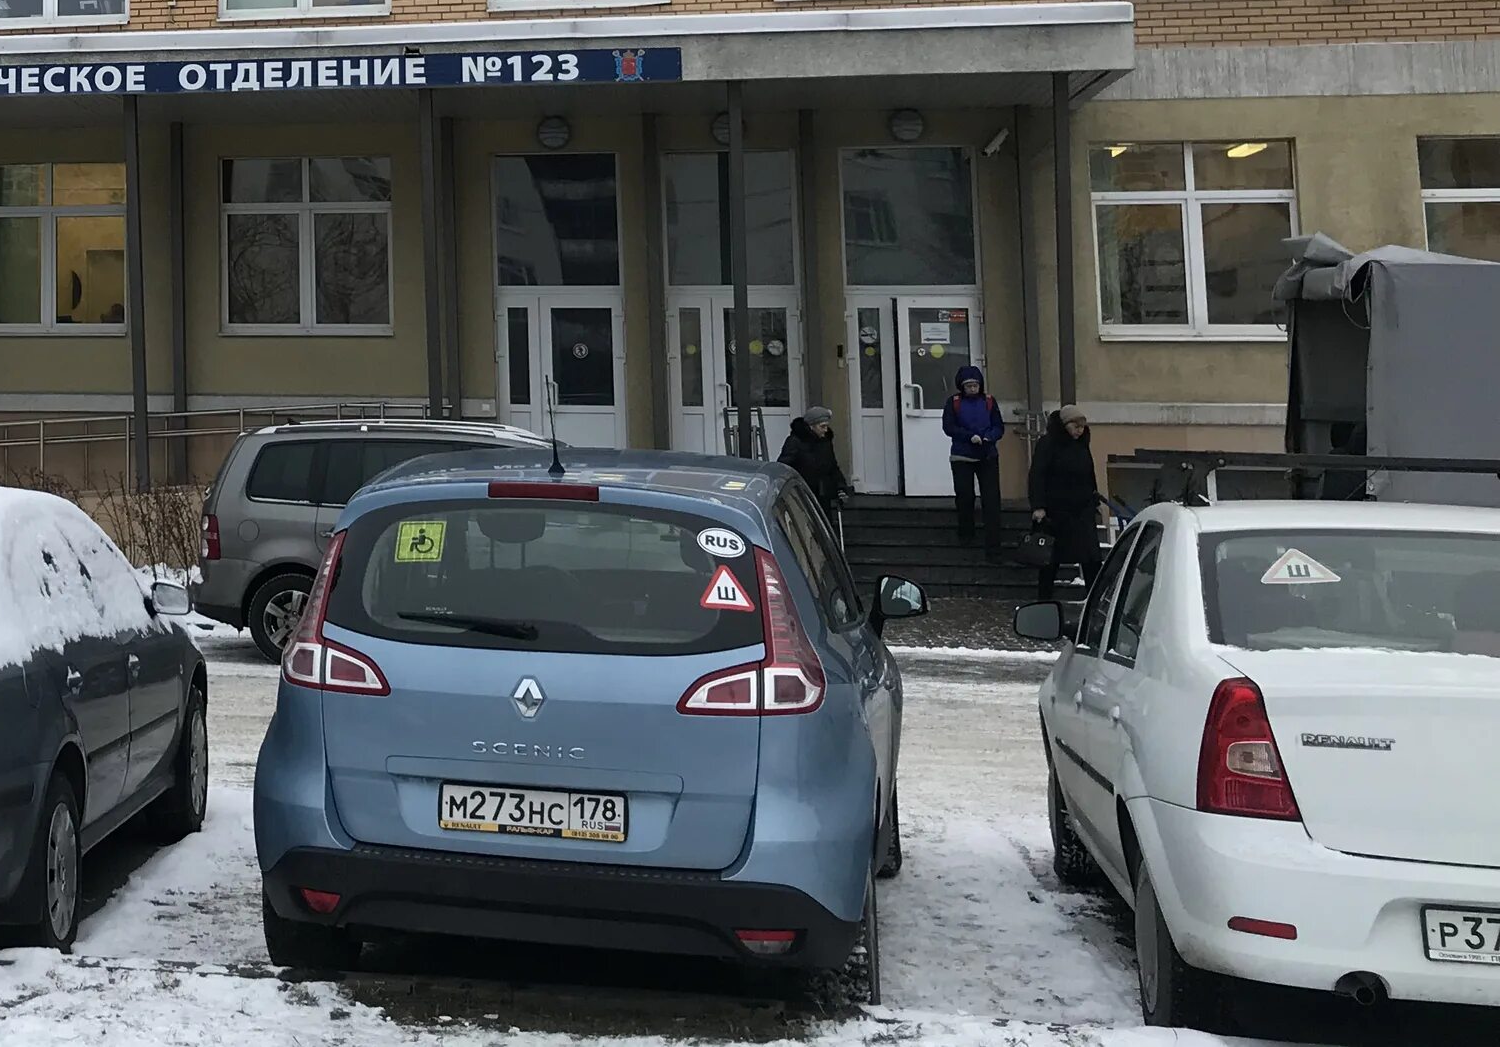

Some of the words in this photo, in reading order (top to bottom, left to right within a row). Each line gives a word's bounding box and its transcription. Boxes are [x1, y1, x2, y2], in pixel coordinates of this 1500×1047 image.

[178, 58, 427, 92] ОТДЕЛЕНИЕ
[462, 53, 581, 82] №123
[705, 535, 739, 551] RUS
[1287, 564, 1311, 578] Ш
[717, 586, 736, 601] Ш
[472, 740, 585, 760] SCENIC
[1301, 733, 1396, 751] RENAULT
[449, 790, 564, 826] М273НС
[573, 796, 616, 822] 178
[581, 820, 604, 830] RUS
